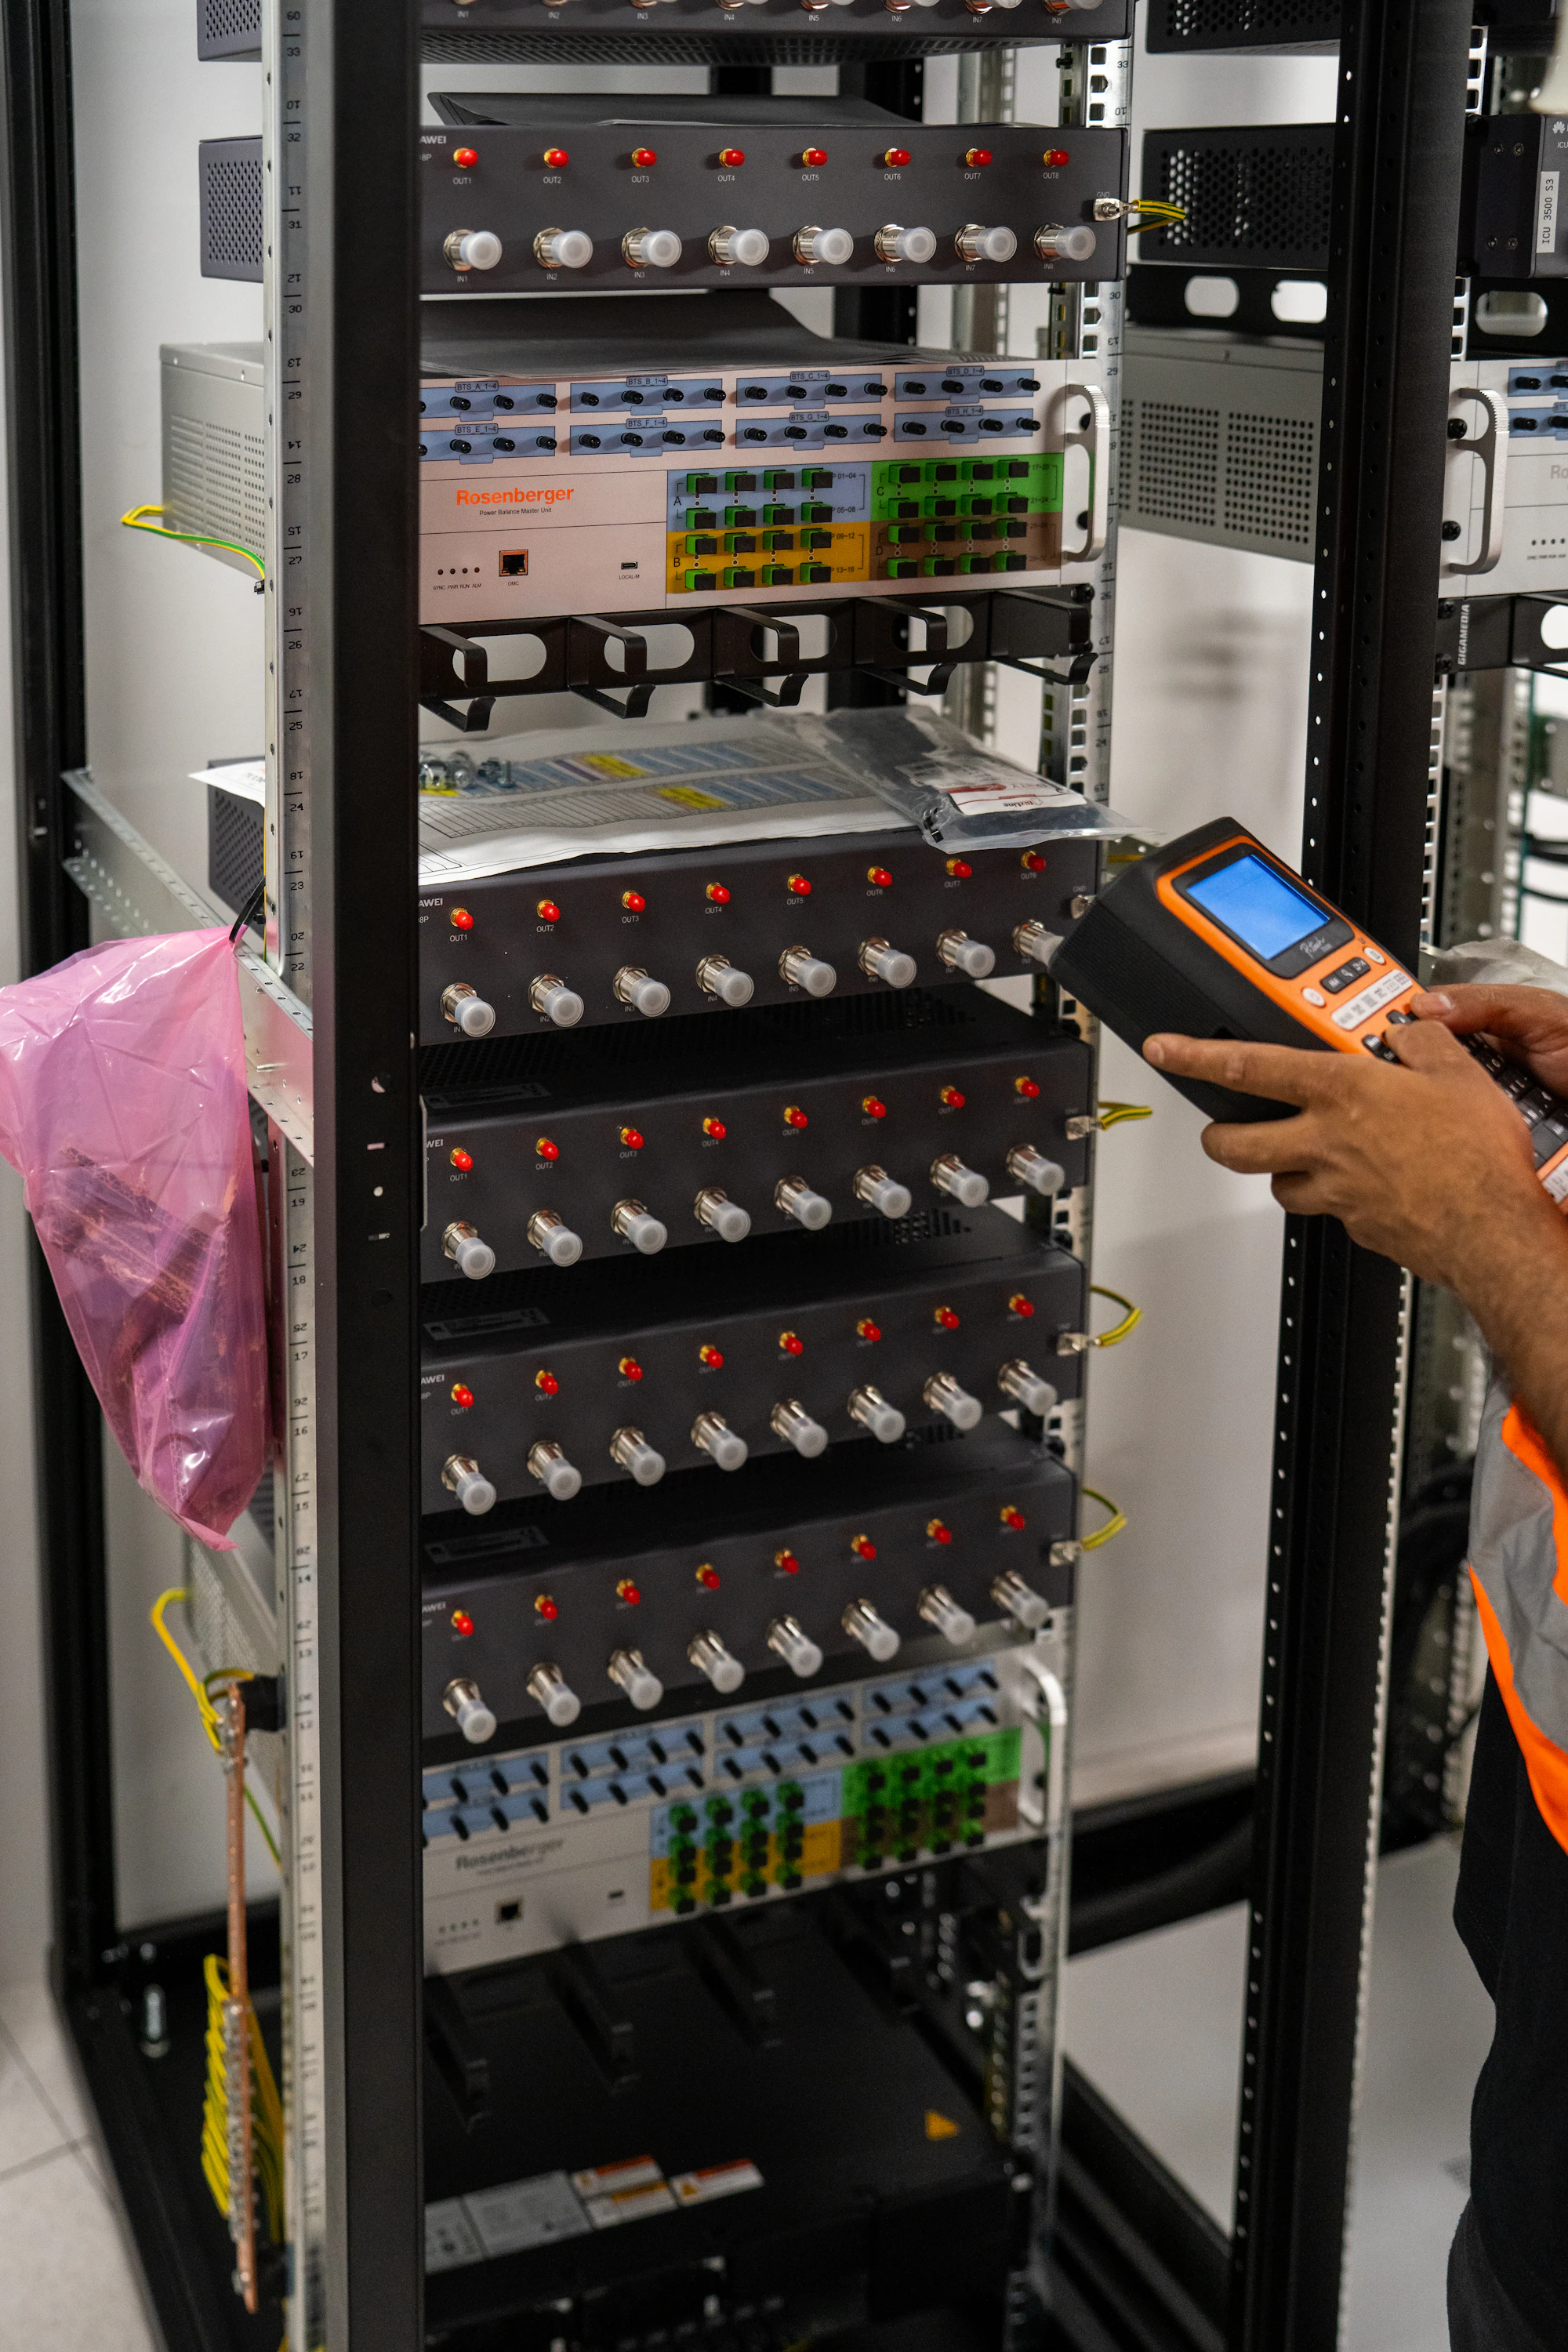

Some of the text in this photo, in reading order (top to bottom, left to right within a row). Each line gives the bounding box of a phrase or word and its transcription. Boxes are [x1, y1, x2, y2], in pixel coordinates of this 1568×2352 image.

[286, 47, 300, 56] 33
[286, 100, 300, 110] 10
[1115, 107, 1127, 115] 10
[287, 133, 301, 142] 32
[289, 187, 302, 195] 11
[1542, 179, 1554, 244] ICU 3500 S3
[289, 220, 302, 229] 31
[288, 274, 301, 283] 12
[289, 305, 302, 314] 30
[288, 358, 301, 367] 13
[287, 474, 301, 484] 28
[877, 486, 884, 496] C
[456, 487, 574, 506] Rosenberger
[673, 496, 682, 506] A
[288, 526, 301, 535] 15
[876, 546, 883, 556] D
[289, 556, 302, 564] 27
[673, 557, 681, 568] B
[289, 607, 302, 616] 16
[1457, 604, 1470, 666] GIGAMEDIA
[289, 641, 302, 650] 26
[289, 721, 303, 730] 25
[289, 771, 303, 780] 18
[290, 803, 304, 811] 24
[290, 850, 304, 859] 19
[290, 882, 304, 891] 23
[786, 897, 804, 906] OUT5
[291, 931, 304, 940] 20
[702, 1139, 719, 1148] OUT4
[292, 1167, 306, 1176] 23
[291, 1198, 305, 1207] 19
[292, 1276, 306, 1285] 18
[294, 1352, 308, 1361] 17
[294, 1427, 308, 1436] 16
